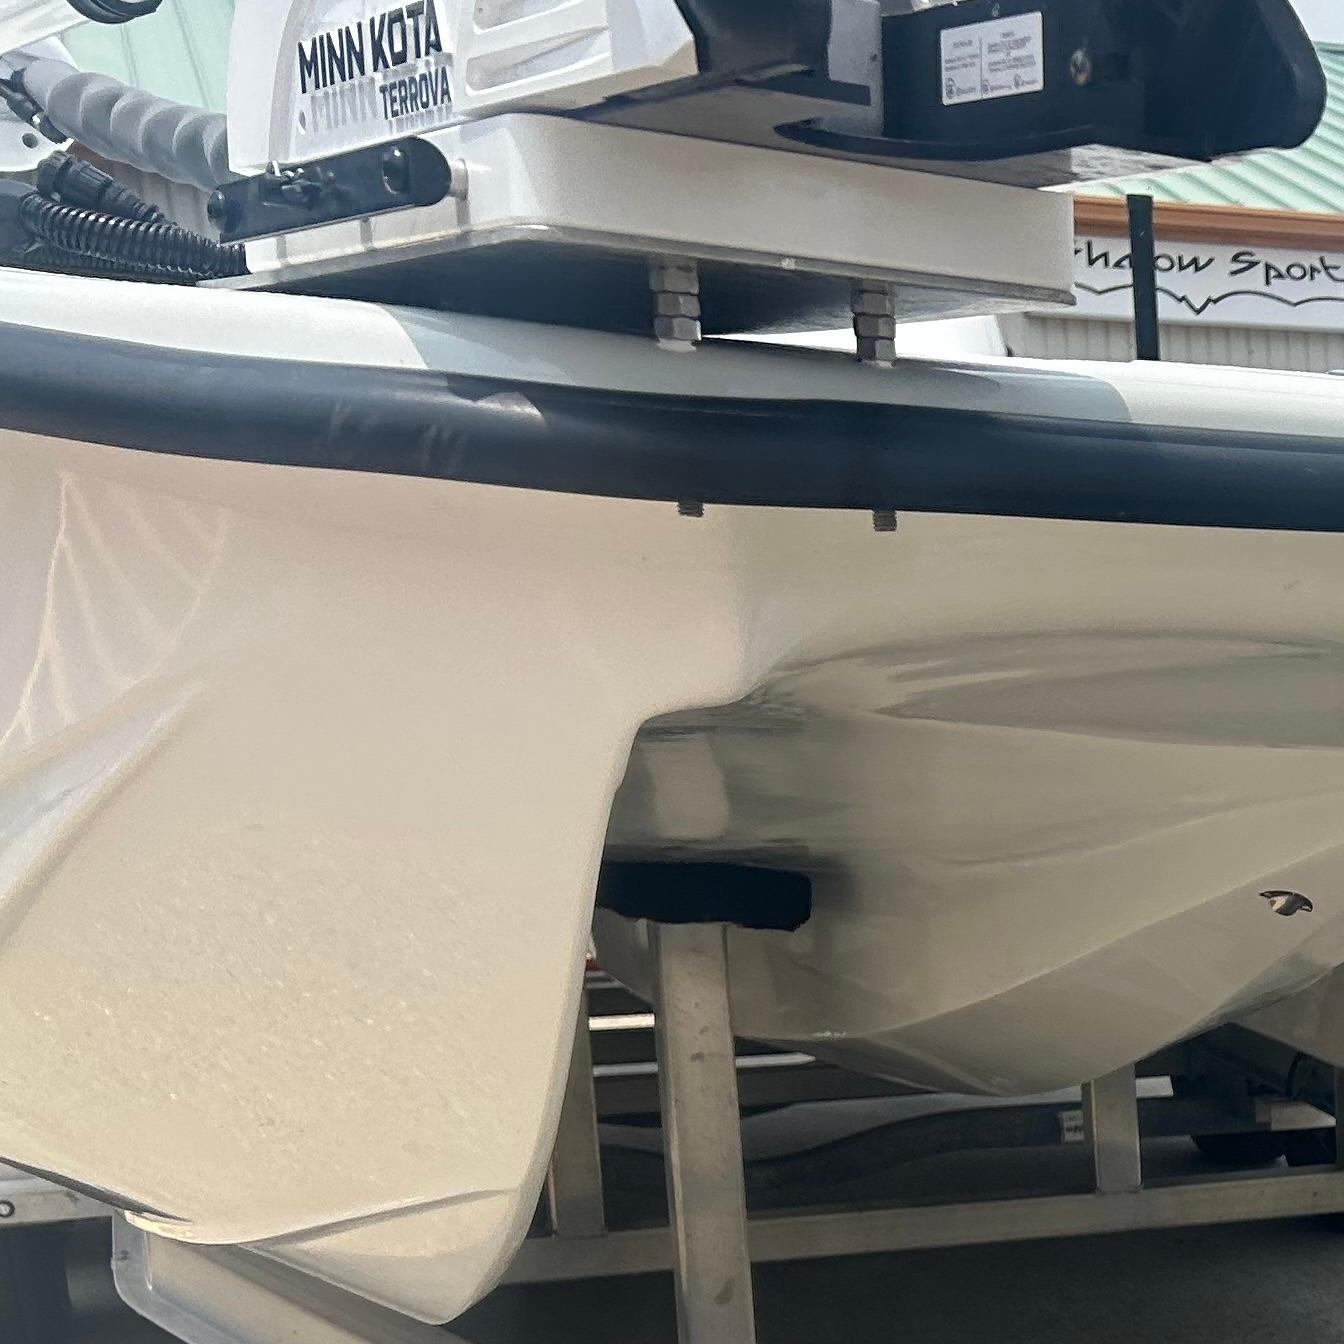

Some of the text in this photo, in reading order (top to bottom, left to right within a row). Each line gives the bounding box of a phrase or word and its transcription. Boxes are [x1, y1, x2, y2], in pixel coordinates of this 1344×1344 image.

[298, 0, 443, 94] MINN KOTA
[379, 66, 452, 120] TERROVA
[1074, 239, 1342, 286] haow Sport
